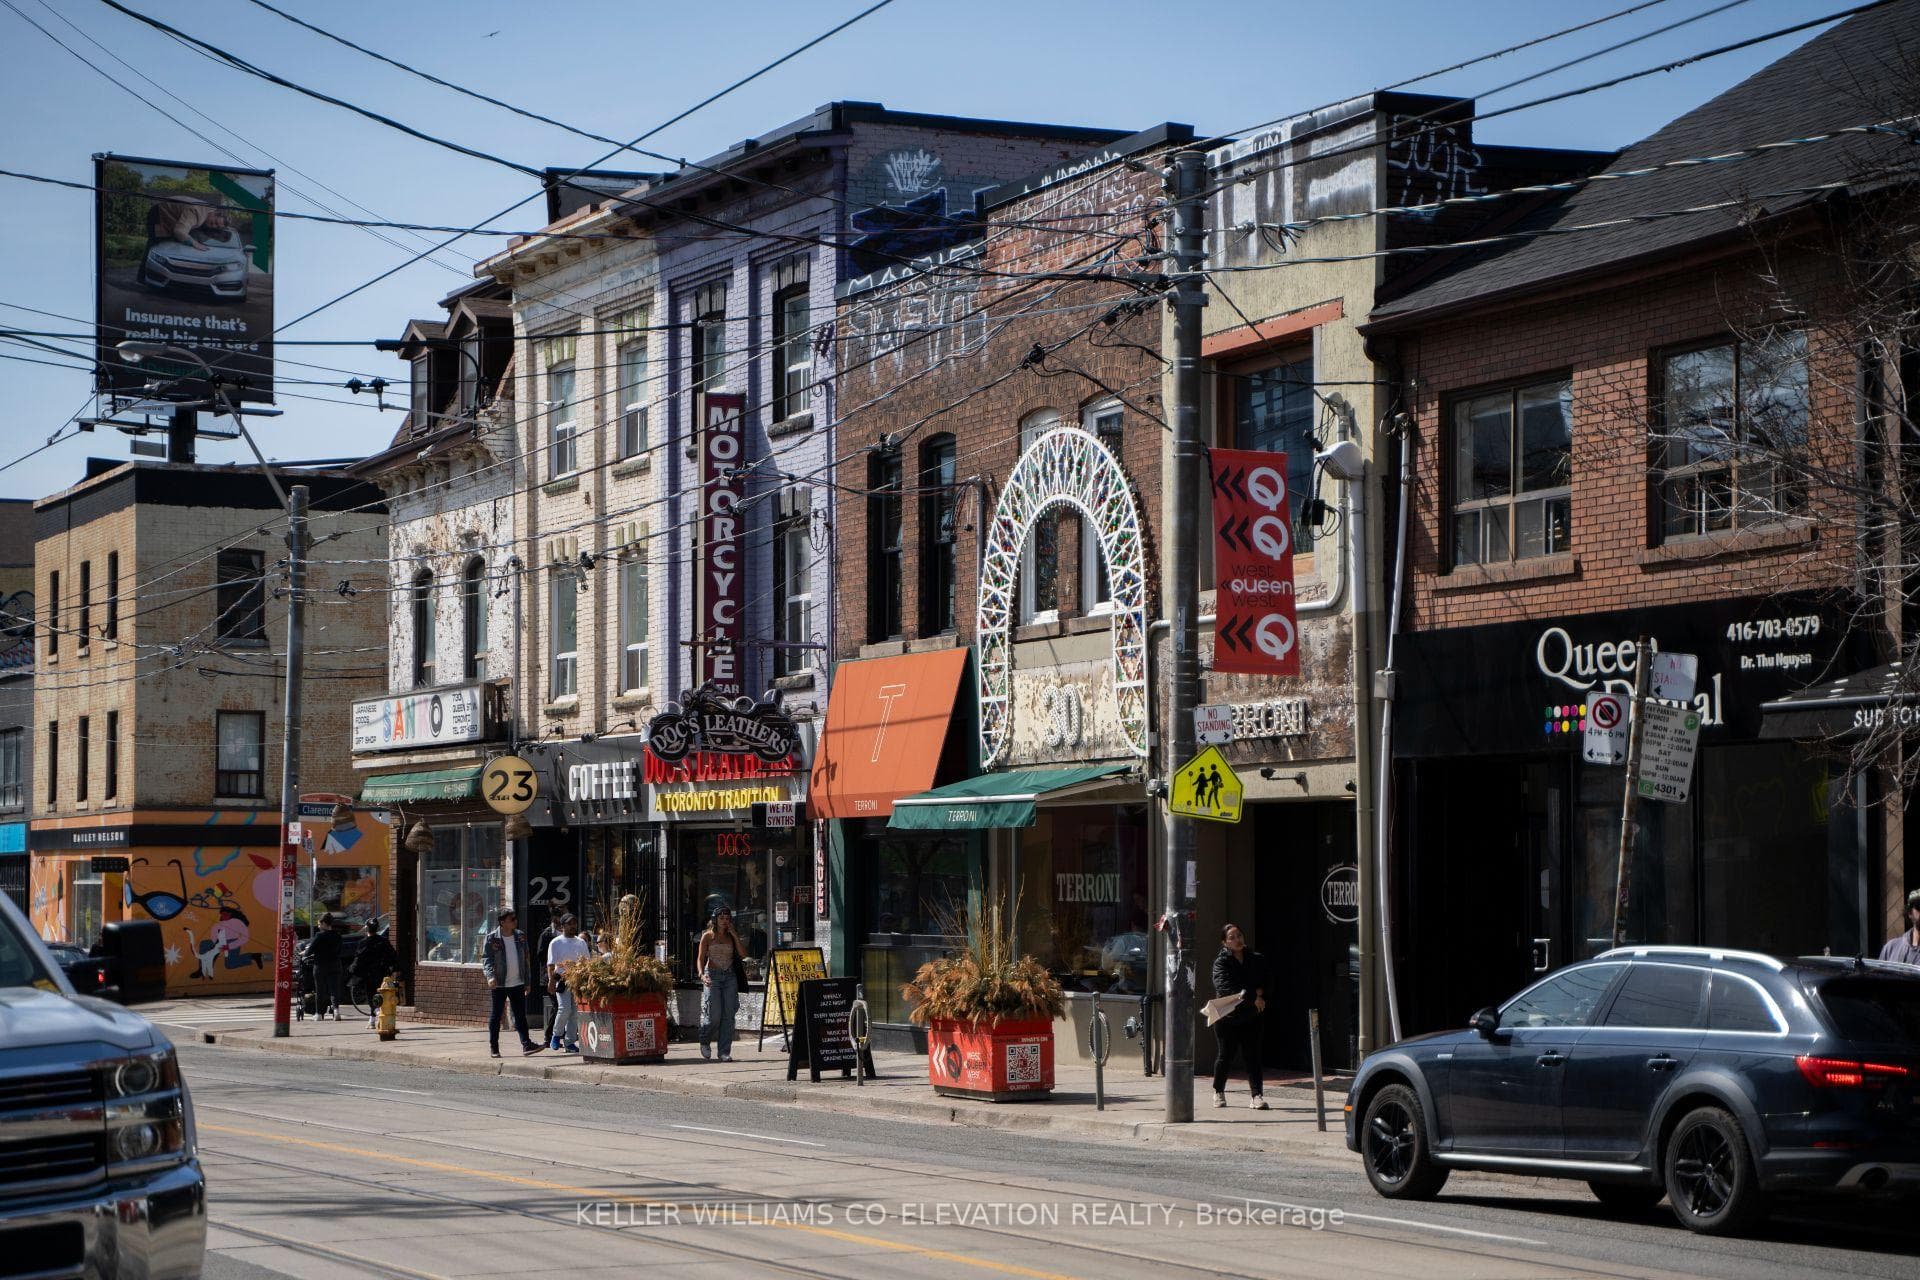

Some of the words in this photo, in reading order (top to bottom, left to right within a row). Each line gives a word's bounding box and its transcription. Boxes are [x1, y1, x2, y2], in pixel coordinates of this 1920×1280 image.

[125, 308, 201, 326] Insurance
[205, 315, 247, 332] that's
[172, 331, 199, 349] big
[203, 336, 221, 348] on
[226, 339, 259, 351] care
[709, 407, 740, 679] MOTORCYCLE
[1231, 564, 1274, 577] west
[1232, 594, 1278, 608] west
[1727, 615, 1820, 641] 416-703-0579
[1741, 655, 1755, 669] Dr.
[1756, 654, 1774, 667] Thu
[1776, 652, 1812, 669] Nguyen
[717, 684, 740, 694] EAR
[1603, 672, 1724, 726] Dal
[355, 704, 377, 714] JAPANESE
[1043, 684, 1080, 746] 30
[1207, 708, 1218, 720] NO
[1659, 707, 1679, 717] PARKING
[355, 716, 369, 724] FOODS
[383, 695, 443, 742] SANKO
[872, 684, 906, 762] T
[1232, 700, 1306, 739] RRONI
[1645, 712, 1670, 723] ENFORCED
[1853, 708, 1885, 728] SUD
[651, 717, 700, 752] DOC'S
[704, 714, 790, 753] LEATHERS
[1196, 719, 1231, 733] STANDING
[1588, 727, 1593, 736] 4
[1608, 730, 1613, 738] 6
[1653, 724, 1668, 733] MON
[1658, 749, 1671, 757] SAT
[642, 746, 691, 784] DOCS
[1655, 764, 1669, 772] SUN
[489, 769, 532, 801] 23
[569, 761, 637, 801] COFFEE
[1654, 783, 1677, 795] 4301
[655, 793, 662, 811] A
[664, 790, 716, 811] TORONTO
[718, 786, 780, 810] TRADITION
[854, 800, 878, 811] TERRONI
[302, 805, 334, 815] Claremo
[769, 804, 780, 813] WE
[782, 803, 793, 813] FIX
[767, 815, 795, 825] SYNTHS
[948, 810, 977, 822] TERRONI
[718, 833, 751, 855] DOCS
[817, 818, 825, 914] TIQUES
[529, 876, 571, 906] 23
[1056, 873, 1121, 903] TERRONI
[1327, 881, 1358, 906] TERRO
[279, 935, 290, 969] west
[792, 954, 804, 962] WE
[780, 964, 791, 973] FIX
[802, 964, 816, 972] BUY
[784, 973, 816, 982] SYNTHS
